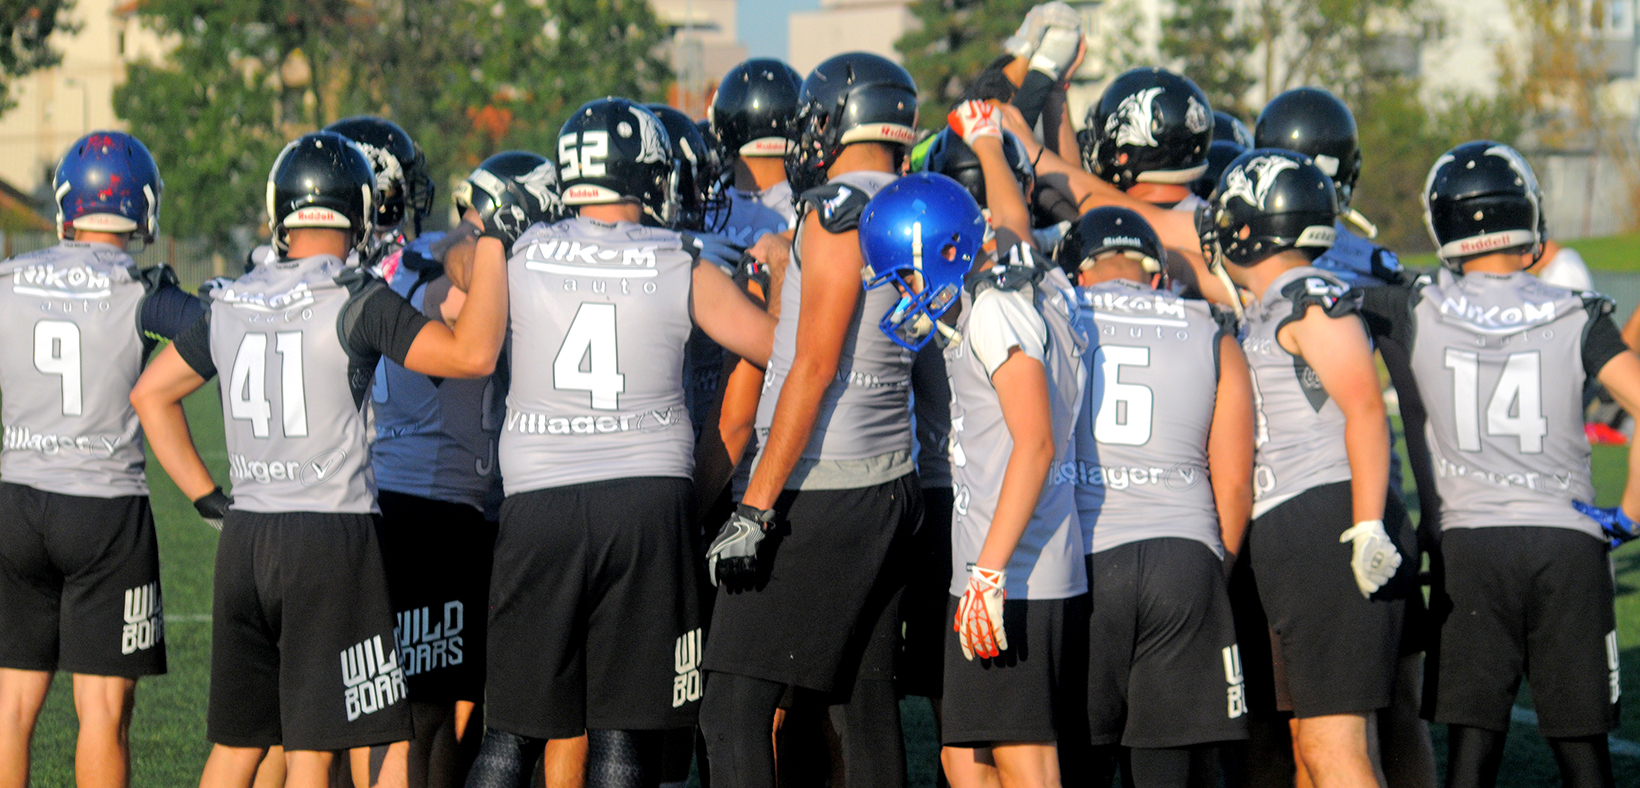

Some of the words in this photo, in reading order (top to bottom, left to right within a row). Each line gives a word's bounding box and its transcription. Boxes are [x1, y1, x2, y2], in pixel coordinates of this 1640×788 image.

[558, 131, 608, 181] 52
[569, 188, 599, 198] Riddell
[298, 211, 335, 221] Riddell
[1460, 234, 1511, 253] Riddell
[563, 278, 657, 294] auto
[40, 298, 110, 313] auto
[1440, 295, 1556, 327] NIKOM
[1103, 324, 1188, 341] auto
[33, 320, 82, 416] 9
[553, 302, 625, 410] 4
[229, 330, 309, 438] 41
[1091, 343, 1153, 446] 6
[1445, 347, 1547, 454] 14
